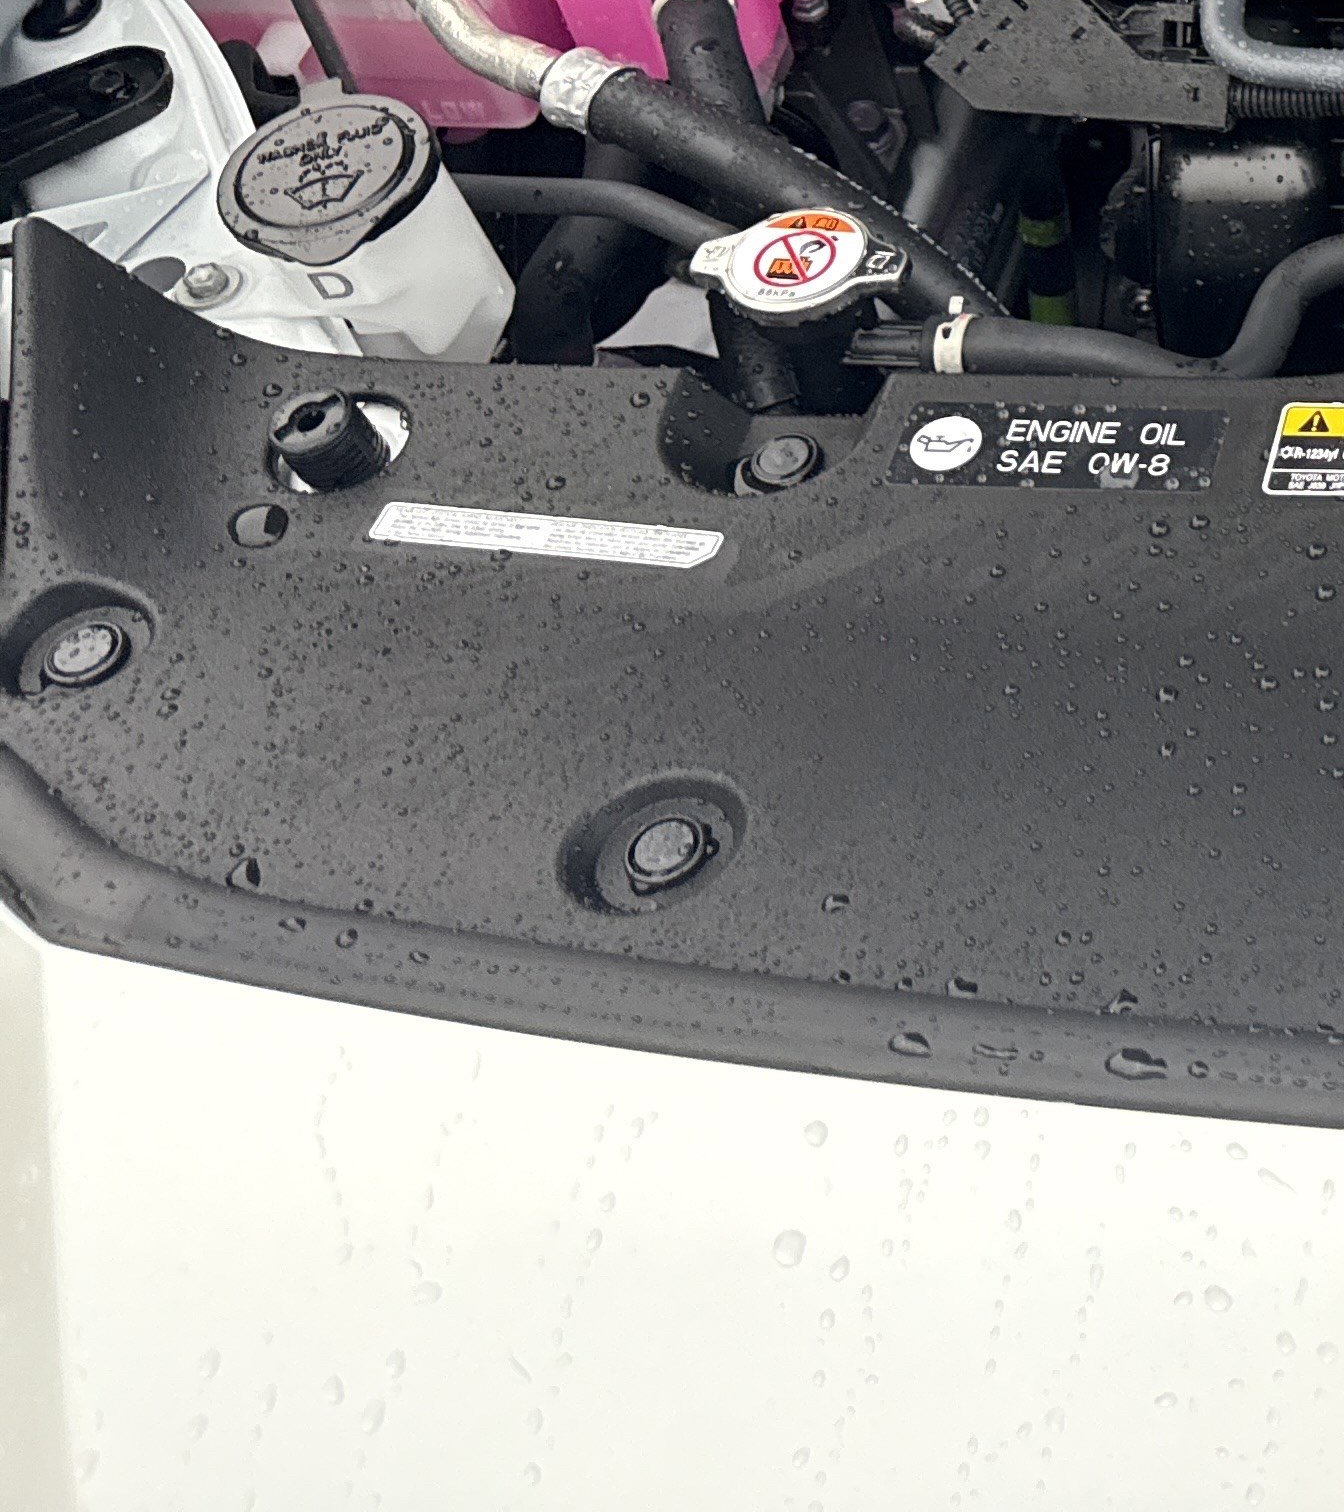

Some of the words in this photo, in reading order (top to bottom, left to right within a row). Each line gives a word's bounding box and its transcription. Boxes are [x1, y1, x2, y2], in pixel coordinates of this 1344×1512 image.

[1005, 418, 1121, 445] ENGINE
[1139, 422, 1186, 446] OIL
[996, 450, 1068, 474] SAE
[1290, 473, 1323, 482] TOYOTA
